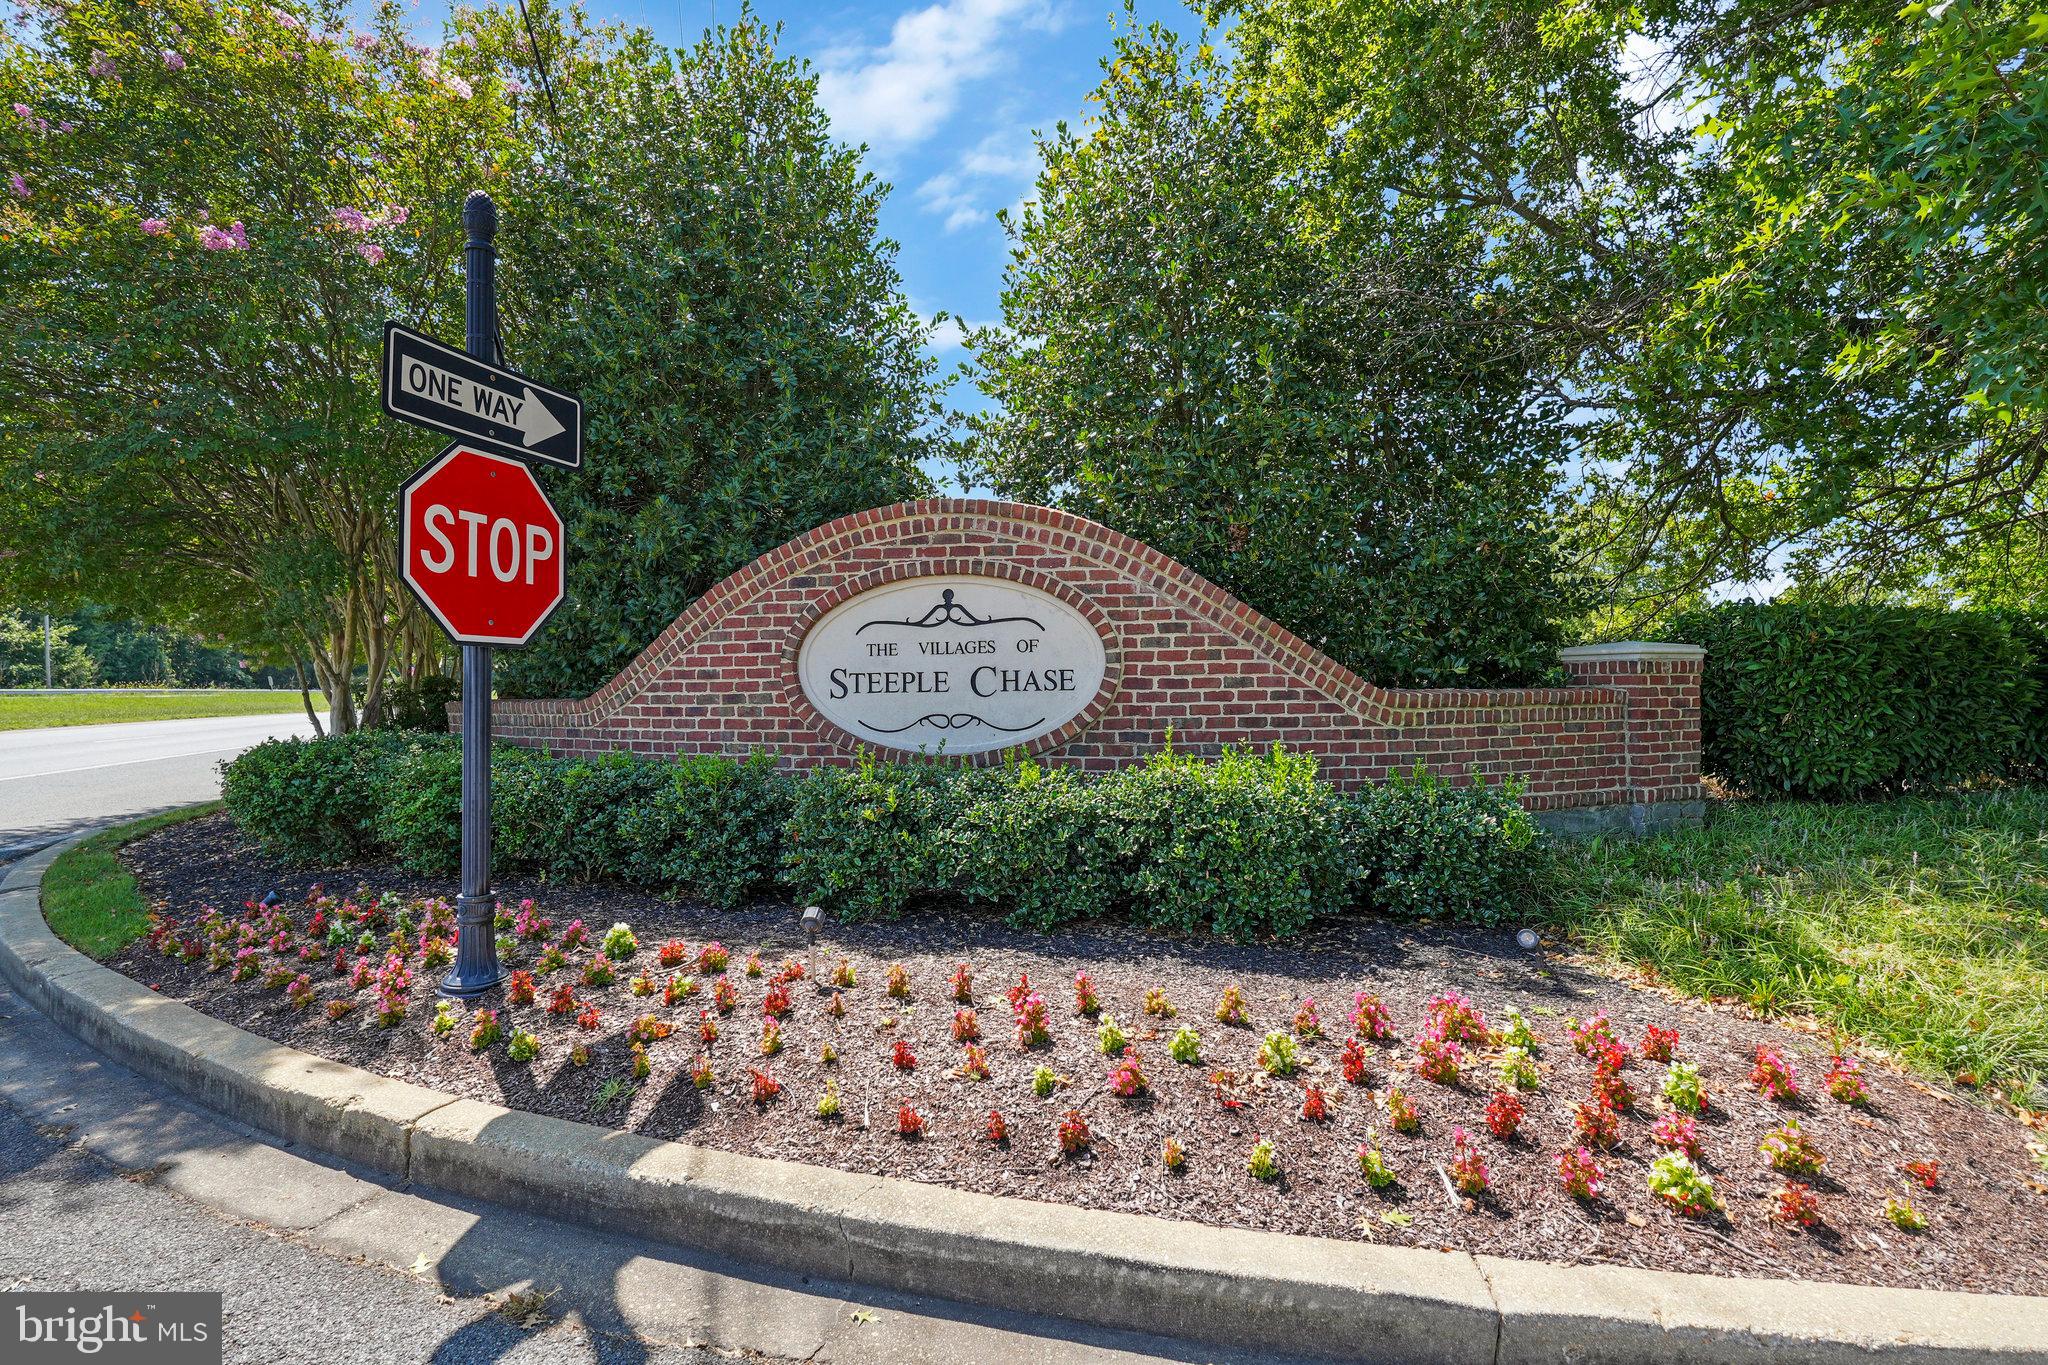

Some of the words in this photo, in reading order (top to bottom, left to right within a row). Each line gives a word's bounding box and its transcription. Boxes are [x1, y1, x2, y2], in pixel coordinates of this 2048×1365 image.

[409, 363, 462, 406] ONE
[473, 385, 523, 425] WAY
[420, 503, 553, 585] STOP
[866, 642, 898, 656] THE
[918, 640, 996, 655] VILLAGES
[1016, 638, 1039, 653] OF
[829, 668, 950, 699] STEEPLE
[970, 666, 1076, 697] CHASE
